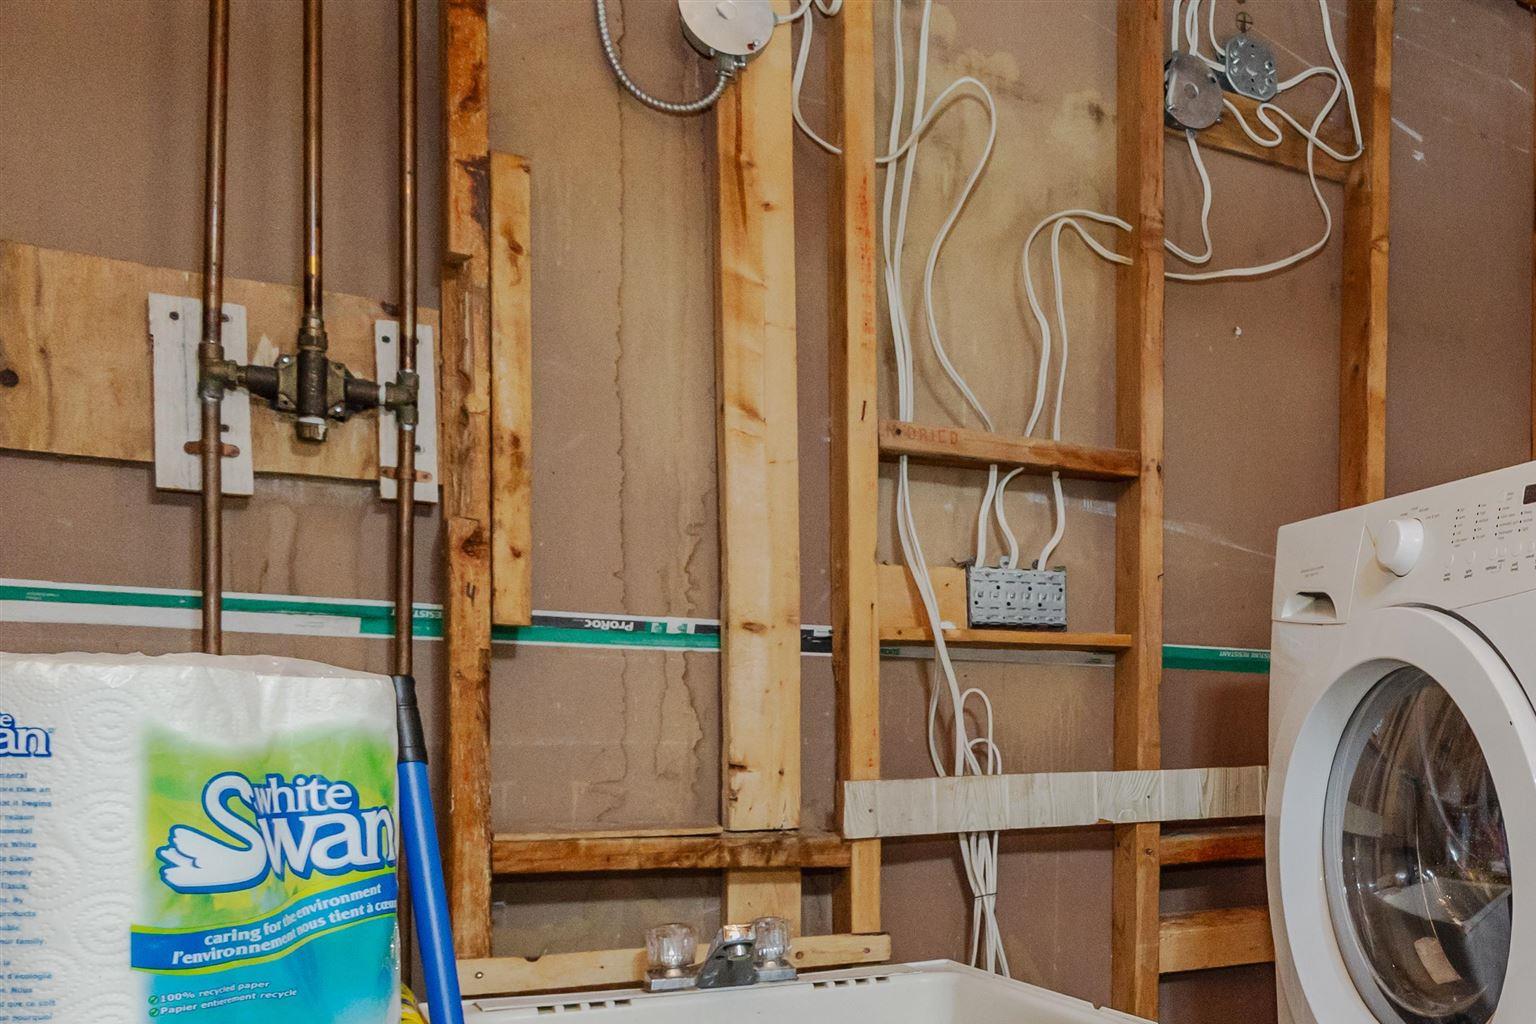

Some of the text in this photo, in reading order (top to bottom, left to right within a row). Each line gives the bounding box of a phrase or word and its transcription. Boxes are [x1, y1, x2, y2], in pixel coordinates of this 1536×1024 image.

[584, 619, 634, 631] ProRoc
[254, 775, 354, 813] white
[163, 774, 396, 889] Swan
[172, 930, 297, 964] l'environnement
[296, 918, 327, 935] nous
[329, 904, 365, 924] tient
[366, 902, 374, 913] à
[204, 883, 382, 947] caring for the environment
[160, 981, 270, 1003] 100% recycled paper
[160, 1004, 198, 1015] Papier
